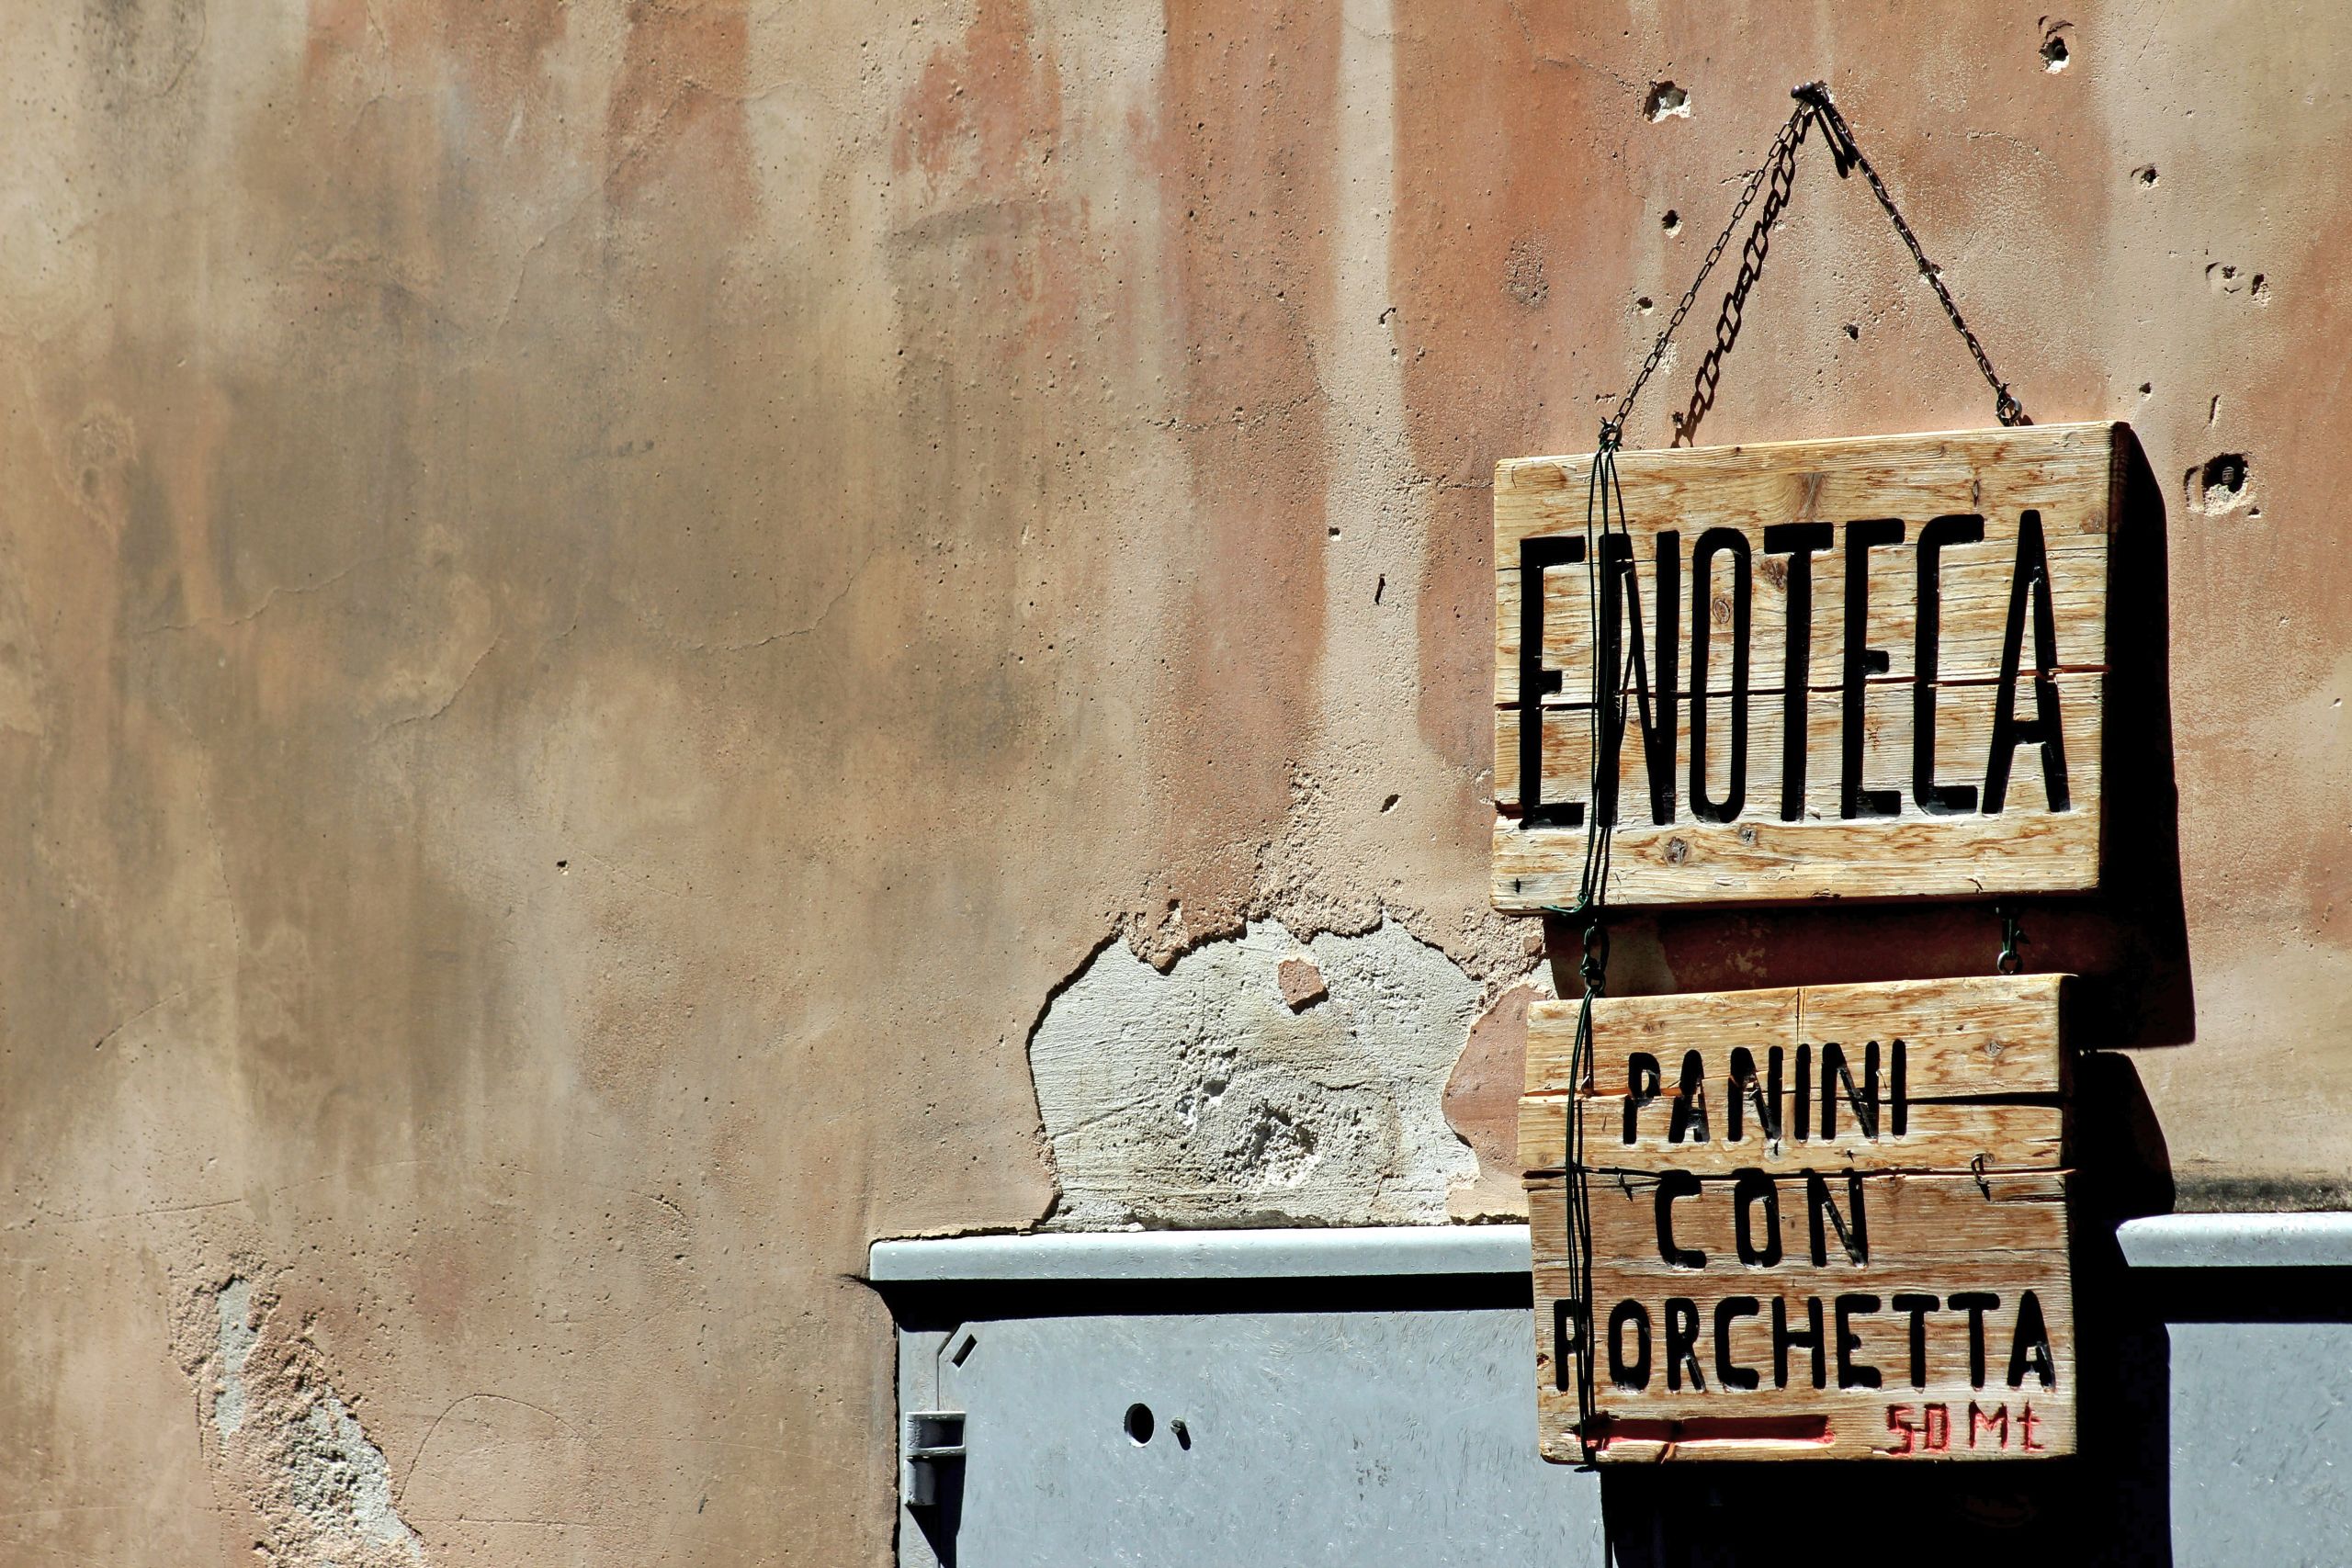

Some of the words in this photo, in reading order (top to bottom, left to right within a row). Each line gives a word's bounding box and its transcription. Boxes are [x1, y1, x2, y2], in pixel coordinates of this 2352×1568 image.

[1520, 509, 2070, 828] ENOTECA
[1623, 1039, 1906, 1145] PANINI
[1656, 1168, 1869, 1268] CON
[1554, 1291, 2055, 1392] PORCHETTA
